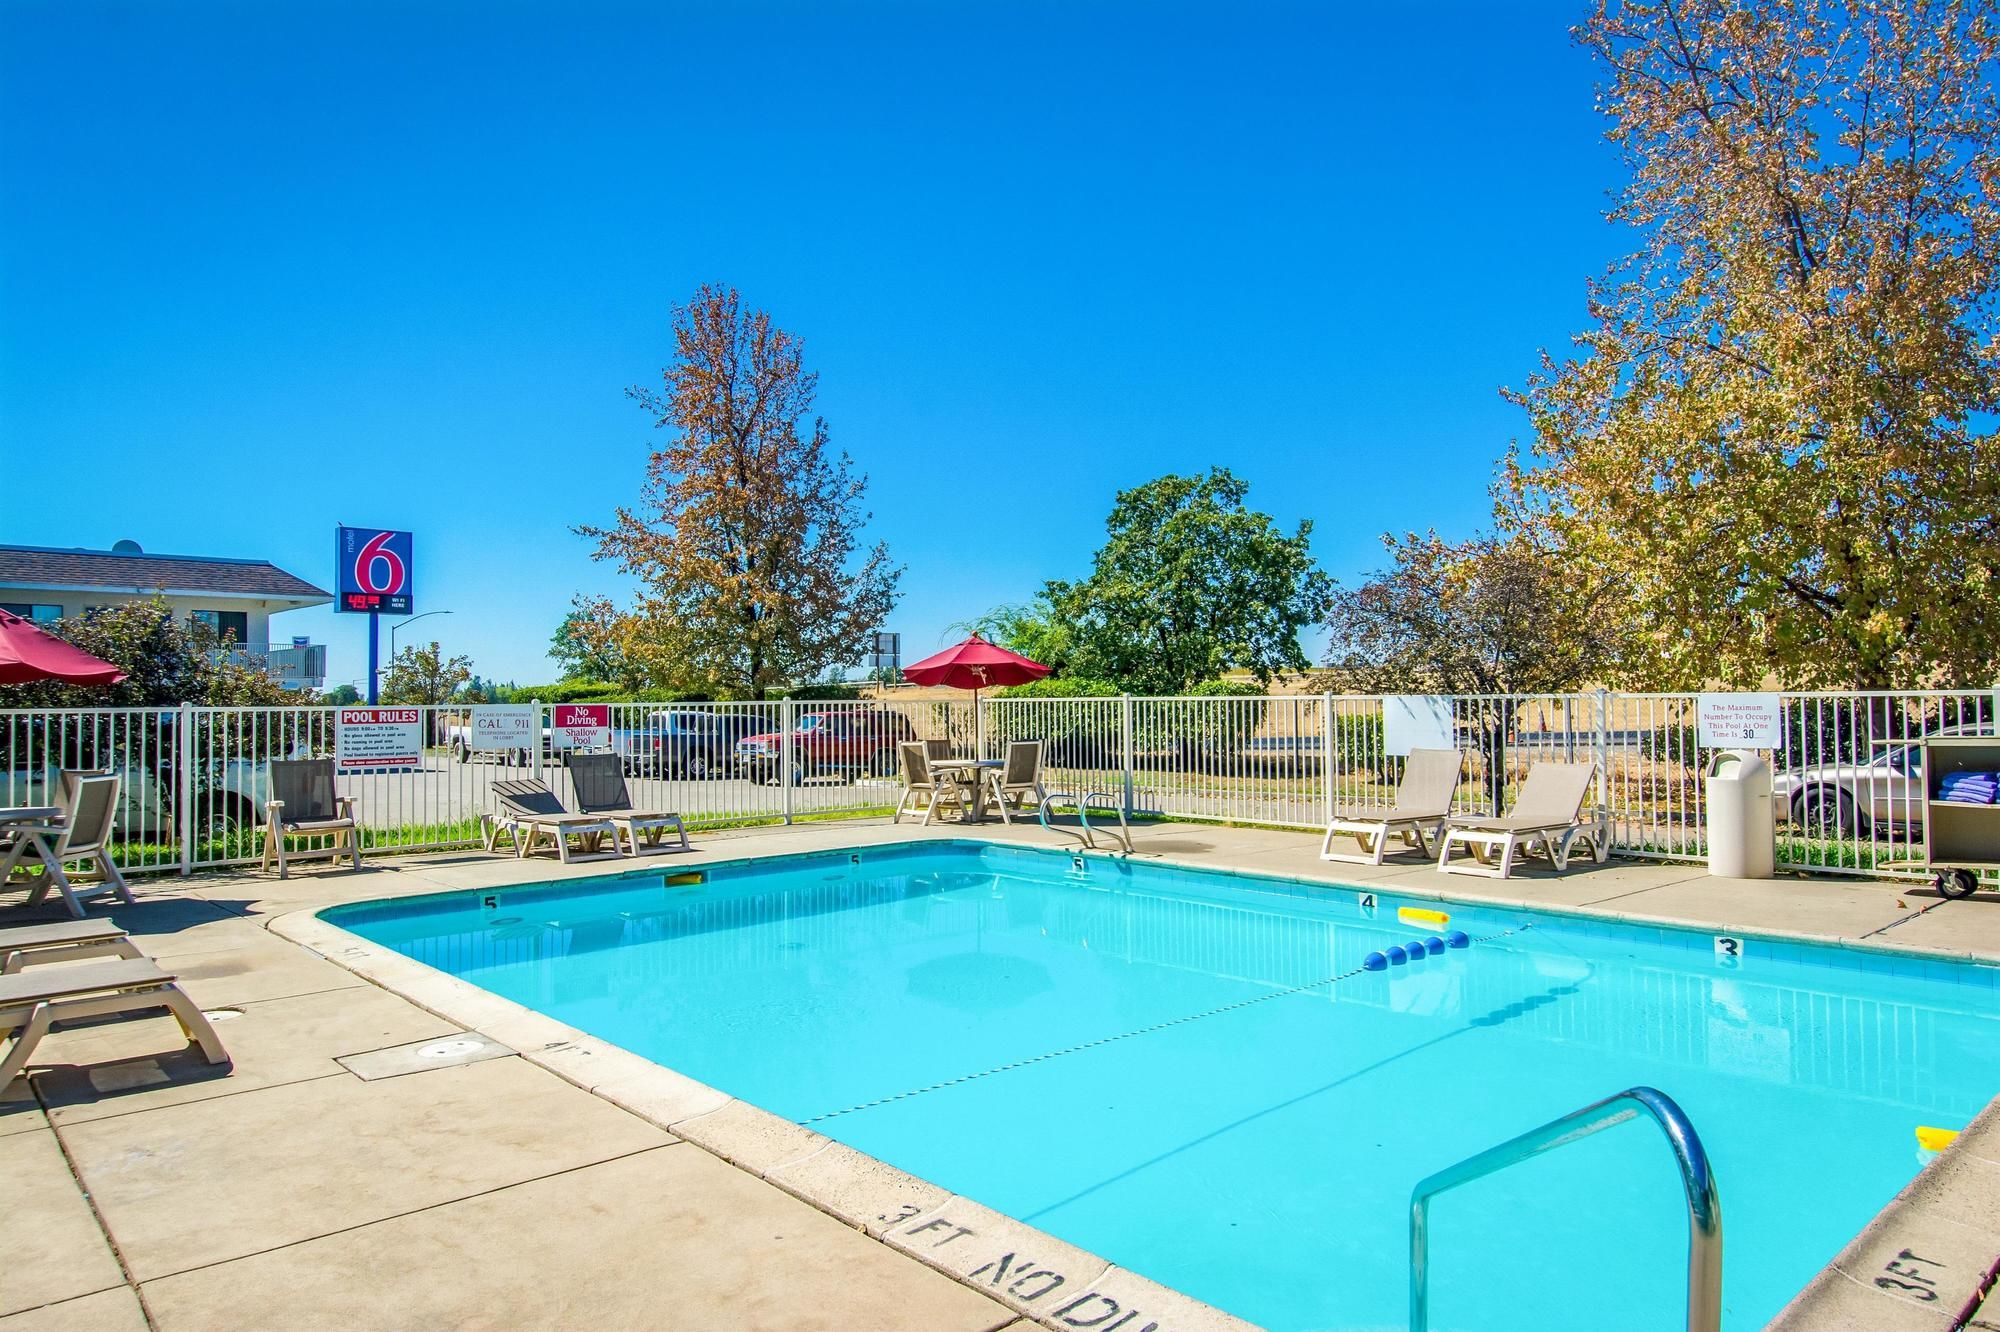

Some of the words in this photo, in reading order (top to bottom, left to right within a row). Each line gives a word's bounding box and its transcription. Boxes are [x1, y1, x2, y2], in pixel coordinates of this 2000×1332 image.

[346, 530, 354, 552] motel
[354, 532, 405, 595] 6
[344, 712, 376, 723] POOL
[379, 711, 416, 722] RULES
[575, 706, 589, 716] No
[515, 719, 529, 728] 911
[567, 716, 597, 726] Diving
[566, 728, 598, 736] Shallow
[1743, 729, 1754, 739] 30
[573, 736, 591, 745] Pool
[851, 854, 860, 864] 5
[1074, 858, 1082, 870] 5
[484, 896, 497, 908] 5
[1362, 895, 1375, 907] 4
[1719, 938, 1738, 955] 3
[968, 1252, 1065, 1301] NO
